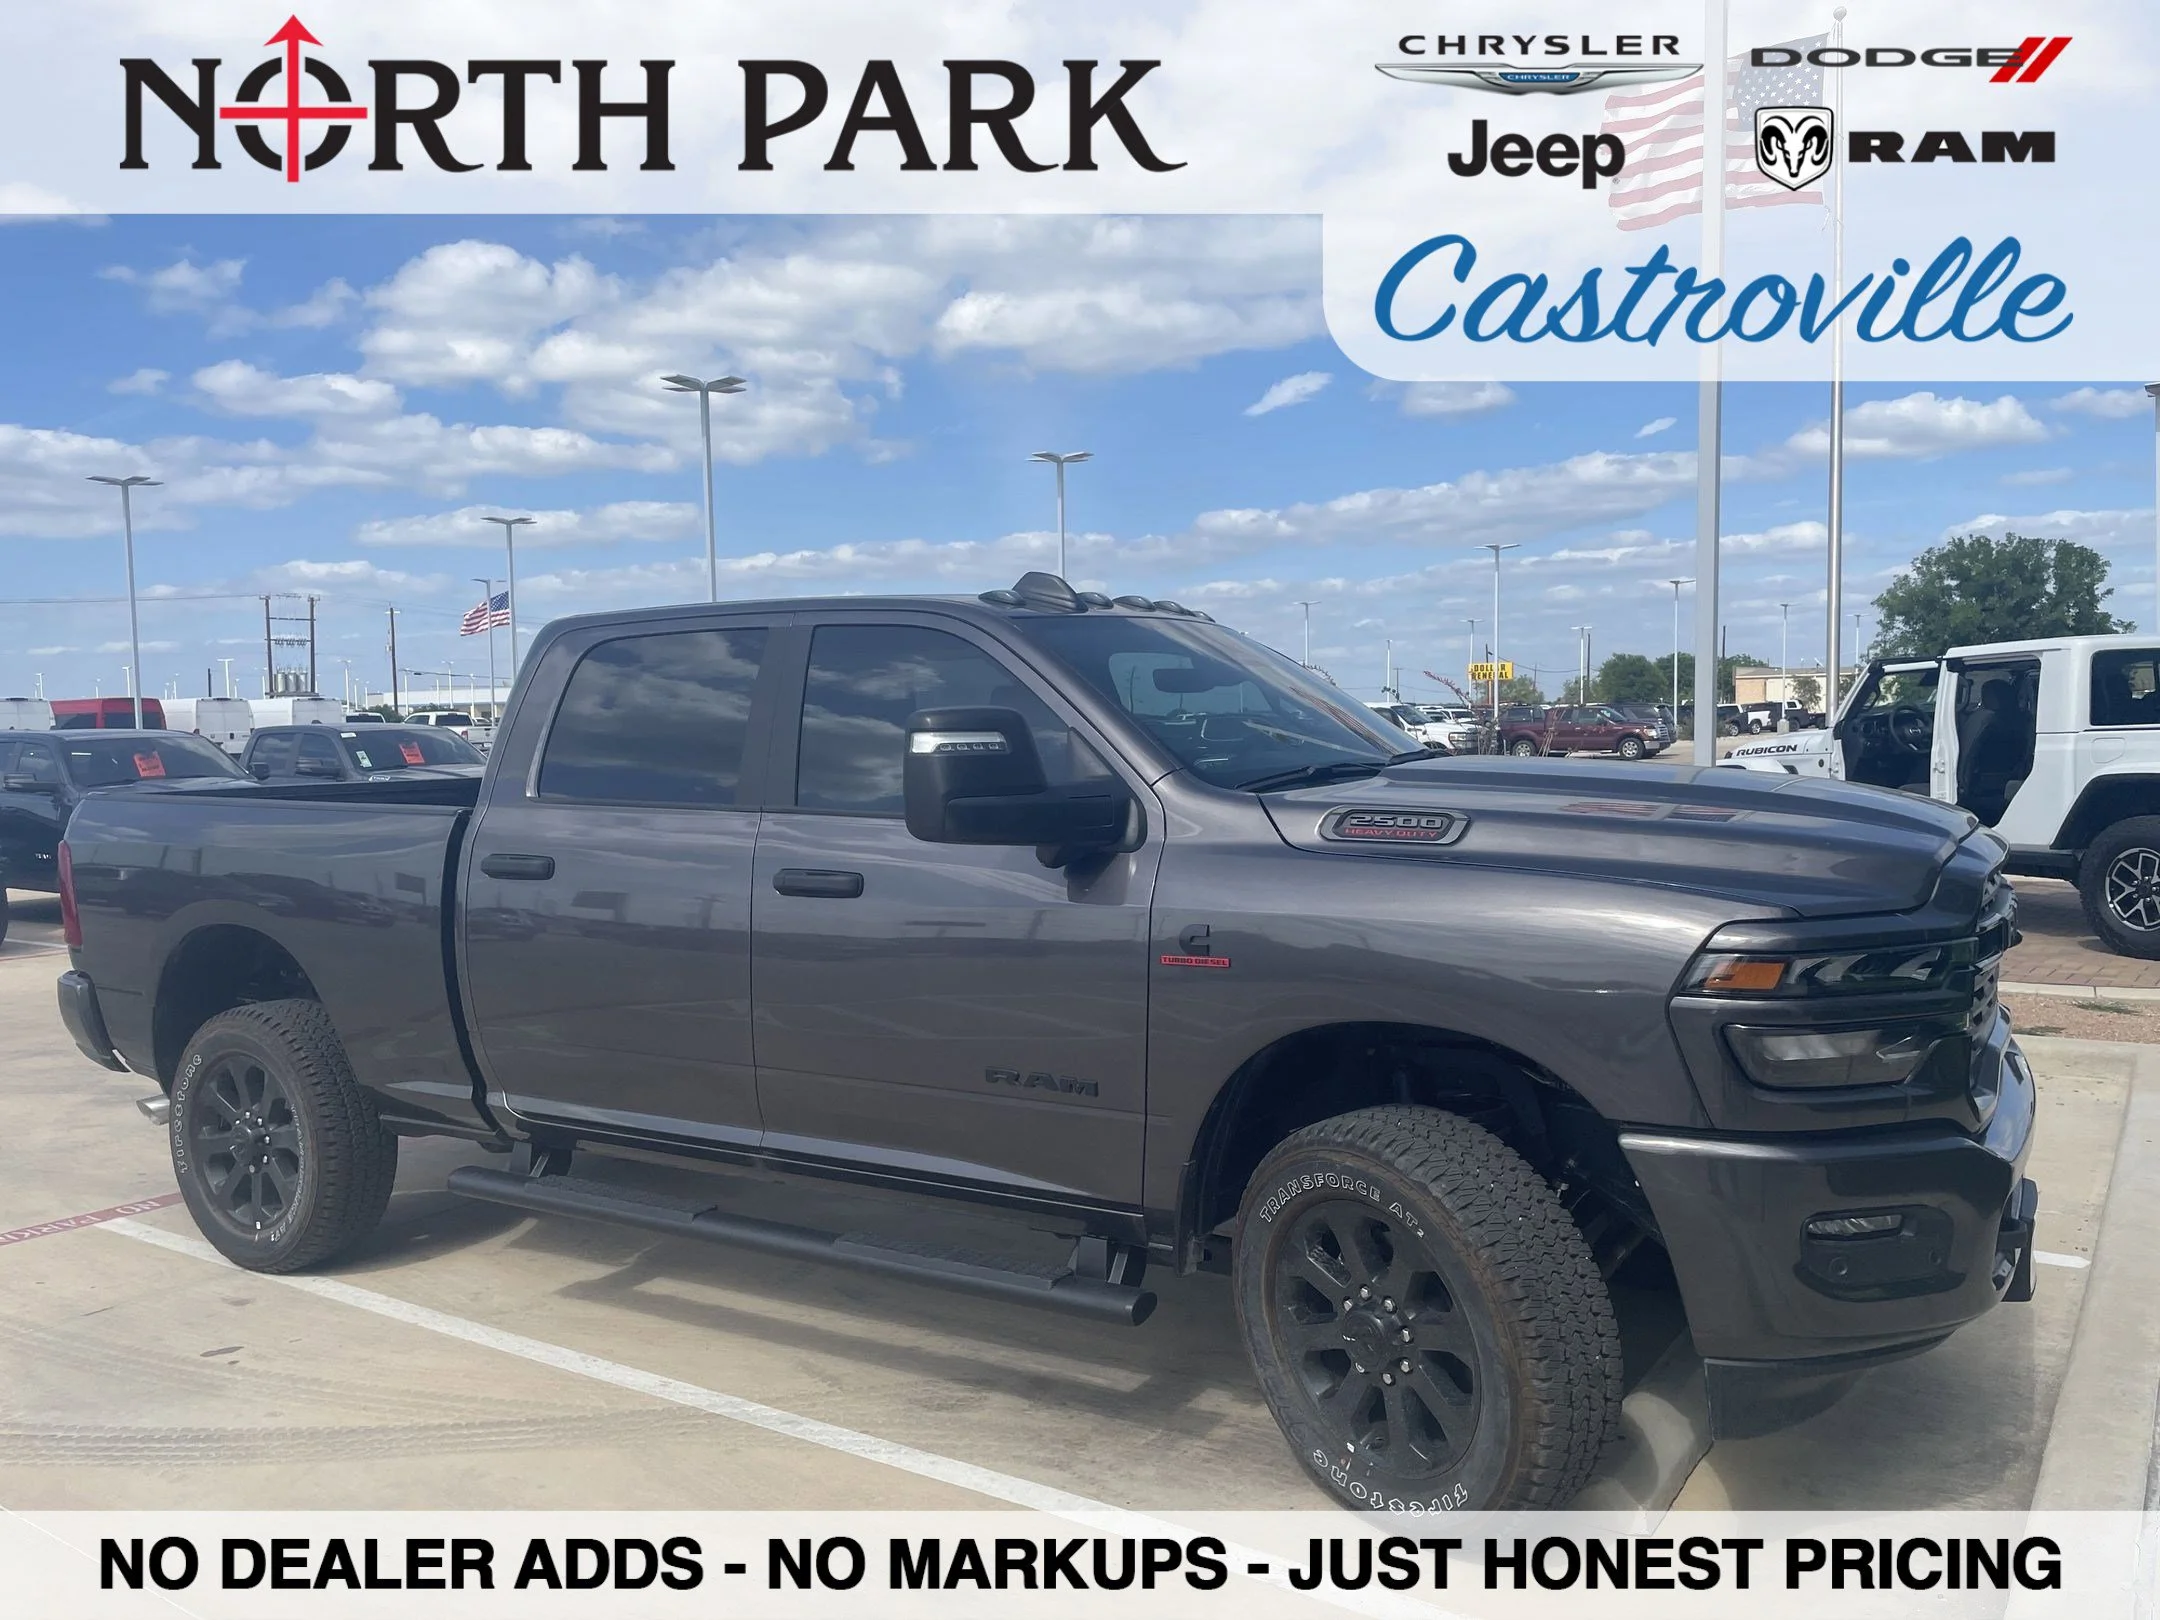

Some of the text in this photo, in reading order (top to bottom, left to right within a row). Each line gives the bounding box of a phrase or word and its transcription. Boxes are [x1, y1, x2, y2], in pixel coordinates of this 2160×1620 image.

[1473, 664, 1507, 673] DOLLR
[1735, 744, 1798, 757] RUBICON
[1350, 814, 1444, 829] 2500
[1344, 827, 1439, 839] HEAVY DUTY
[1162, 956, 1228, 966] TURBO DIESEL
[984, 1065, 1099, 1098] RAM
[1259, 1171, 1382, 1224] TRANSFORCE
[114, 1200, 161, 1215] NO
